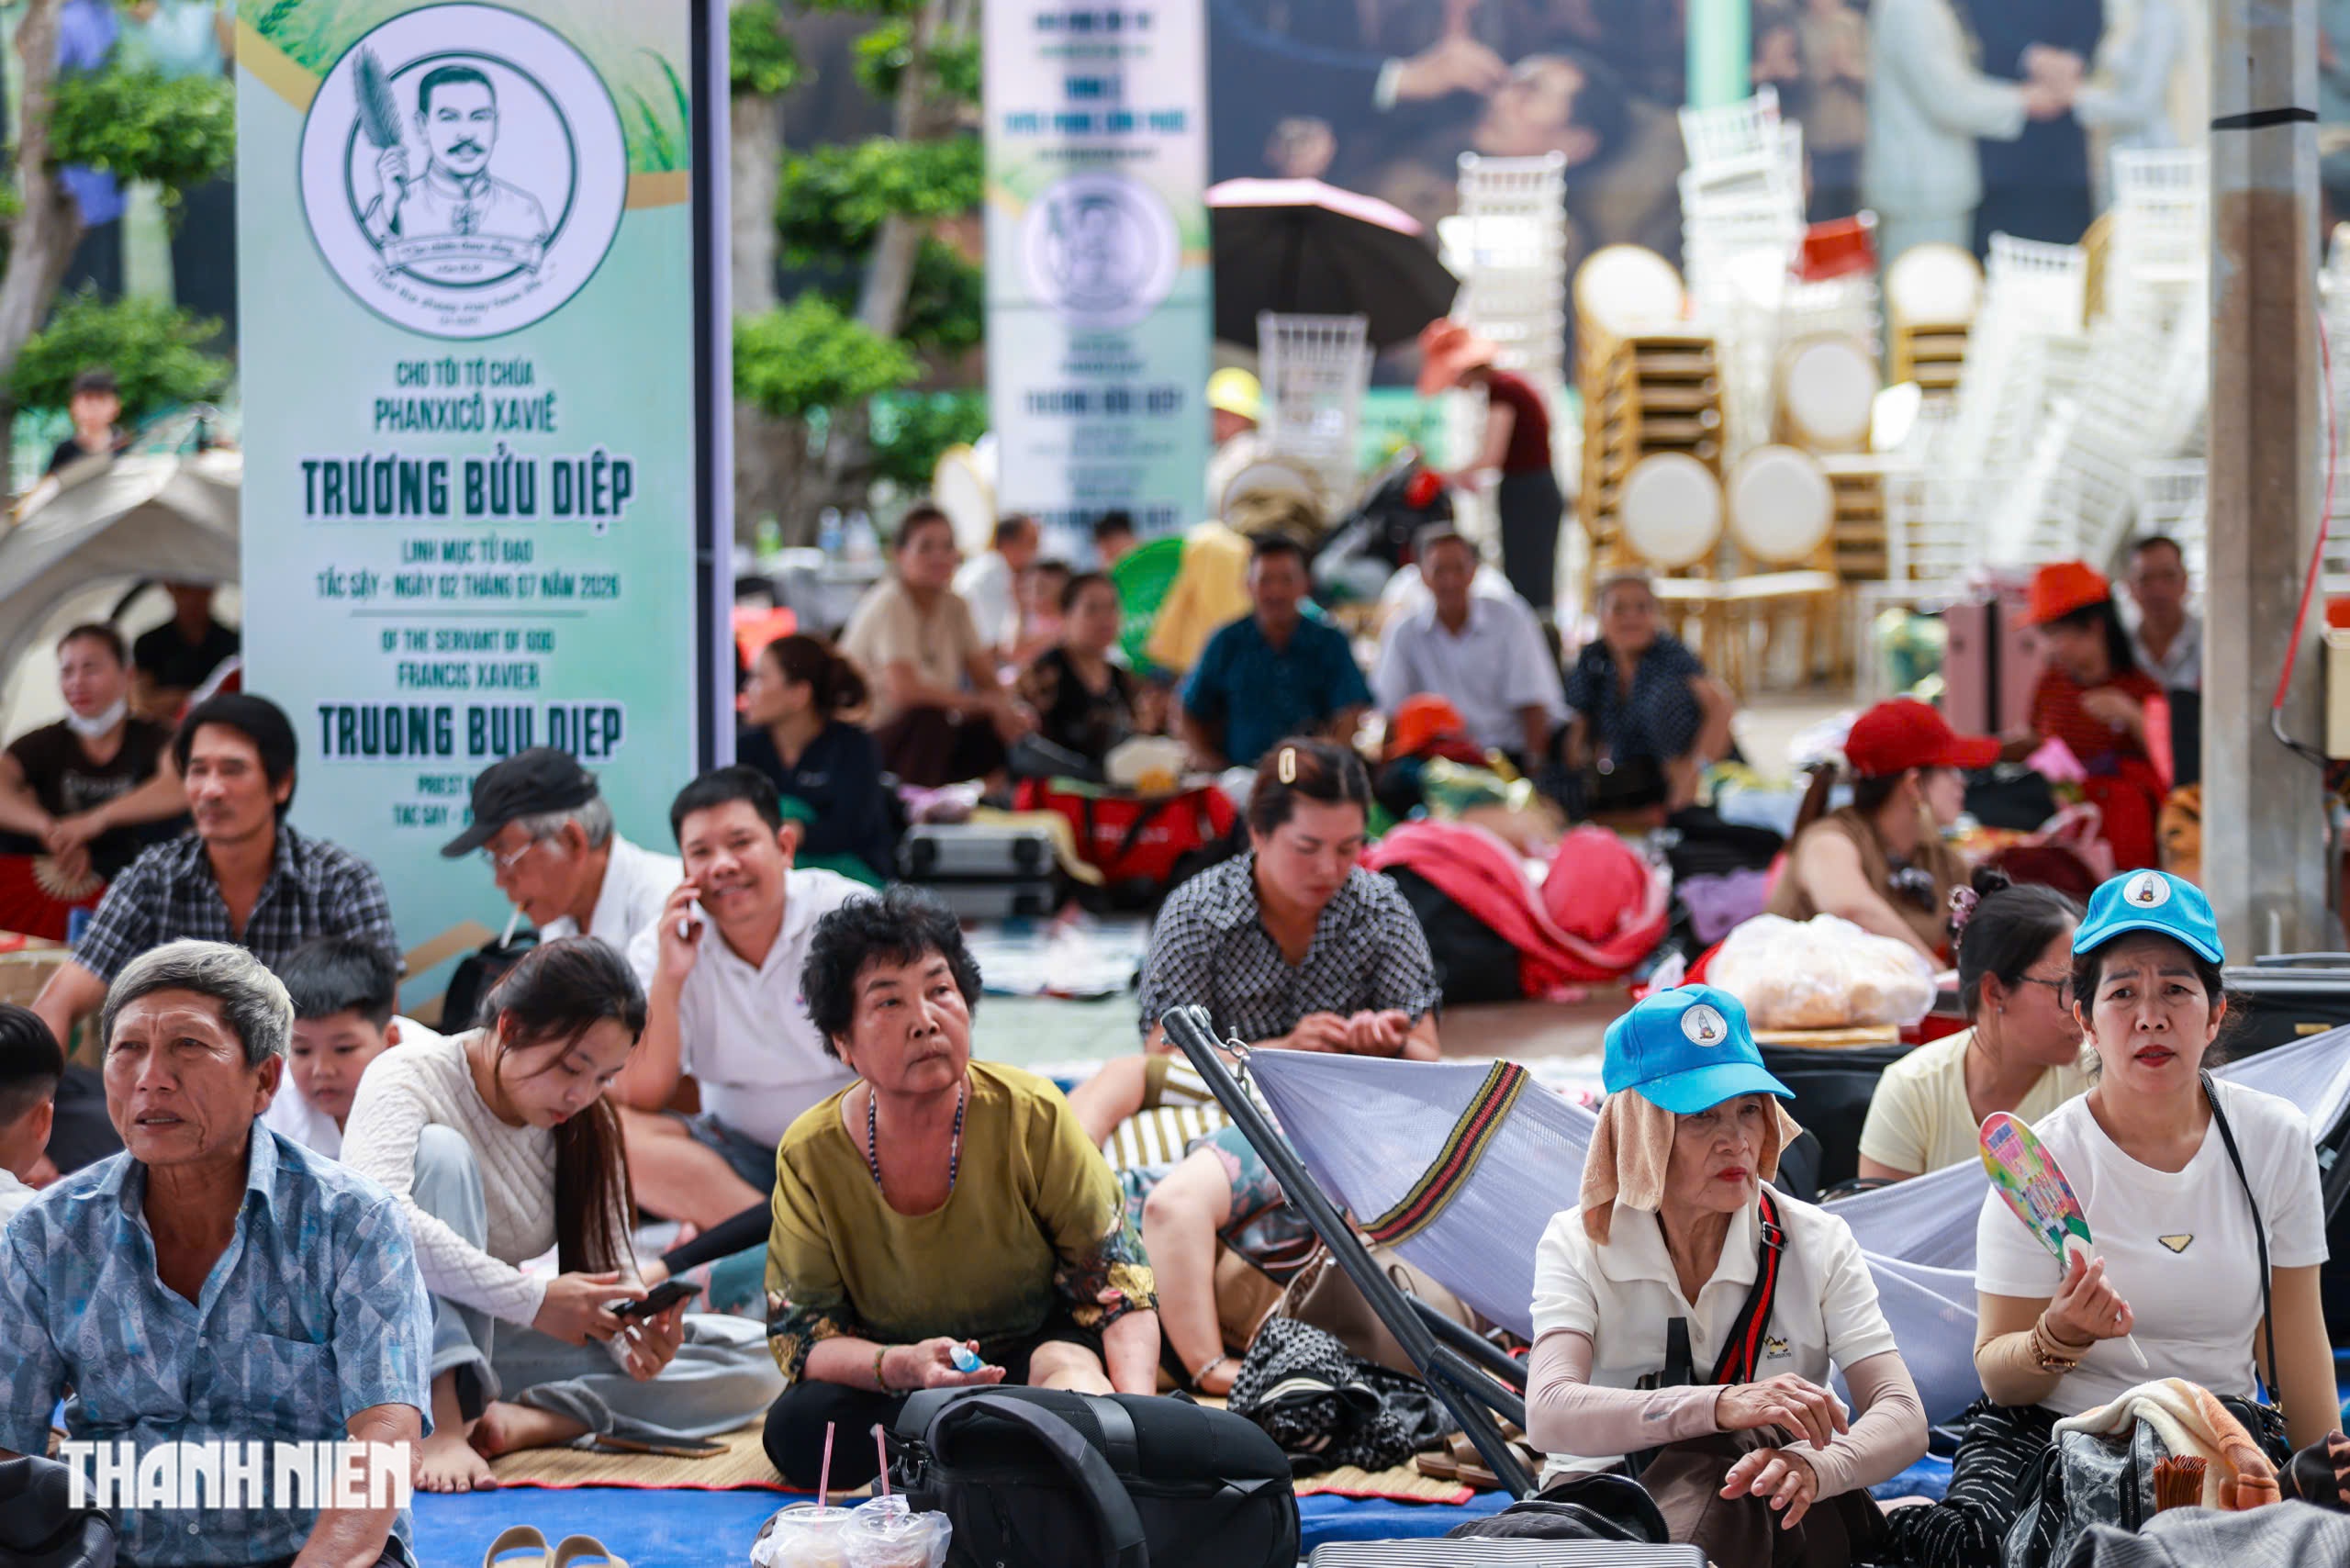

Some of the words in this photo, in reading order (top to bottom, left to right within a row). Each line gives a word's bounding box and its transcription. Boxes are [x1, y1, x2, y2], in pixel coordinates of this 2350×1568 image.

[397, 361, 430, 386] CHO
[489, 356, 534, 386] CHÚA
[375, 392, 486, 432] PHANXICÔ
[301, 453, 449, 516] TRƯƠNG
[464, 442, 536, 516] BỬU
[552, 450, 632, 530] DIỆP
[403, 540, 437, 564] LINH
[439, 574, 459, 598] 02
[382, 630, 397, 652] OF
[404, 629, 428, 651] THE
[435, 630, 499, 652] SERVANT
[504, 631, 520, 652] OF
[526, 630, 555, 653] GOD
[397, 662, 471, 690] FRANCIS
[477, 662, 541, 690] XAVIER
[319, 706, 453, 756] TRUONG
[467, 707, 534, 756] BUU
[546, 707, 621, 756] DIEP
